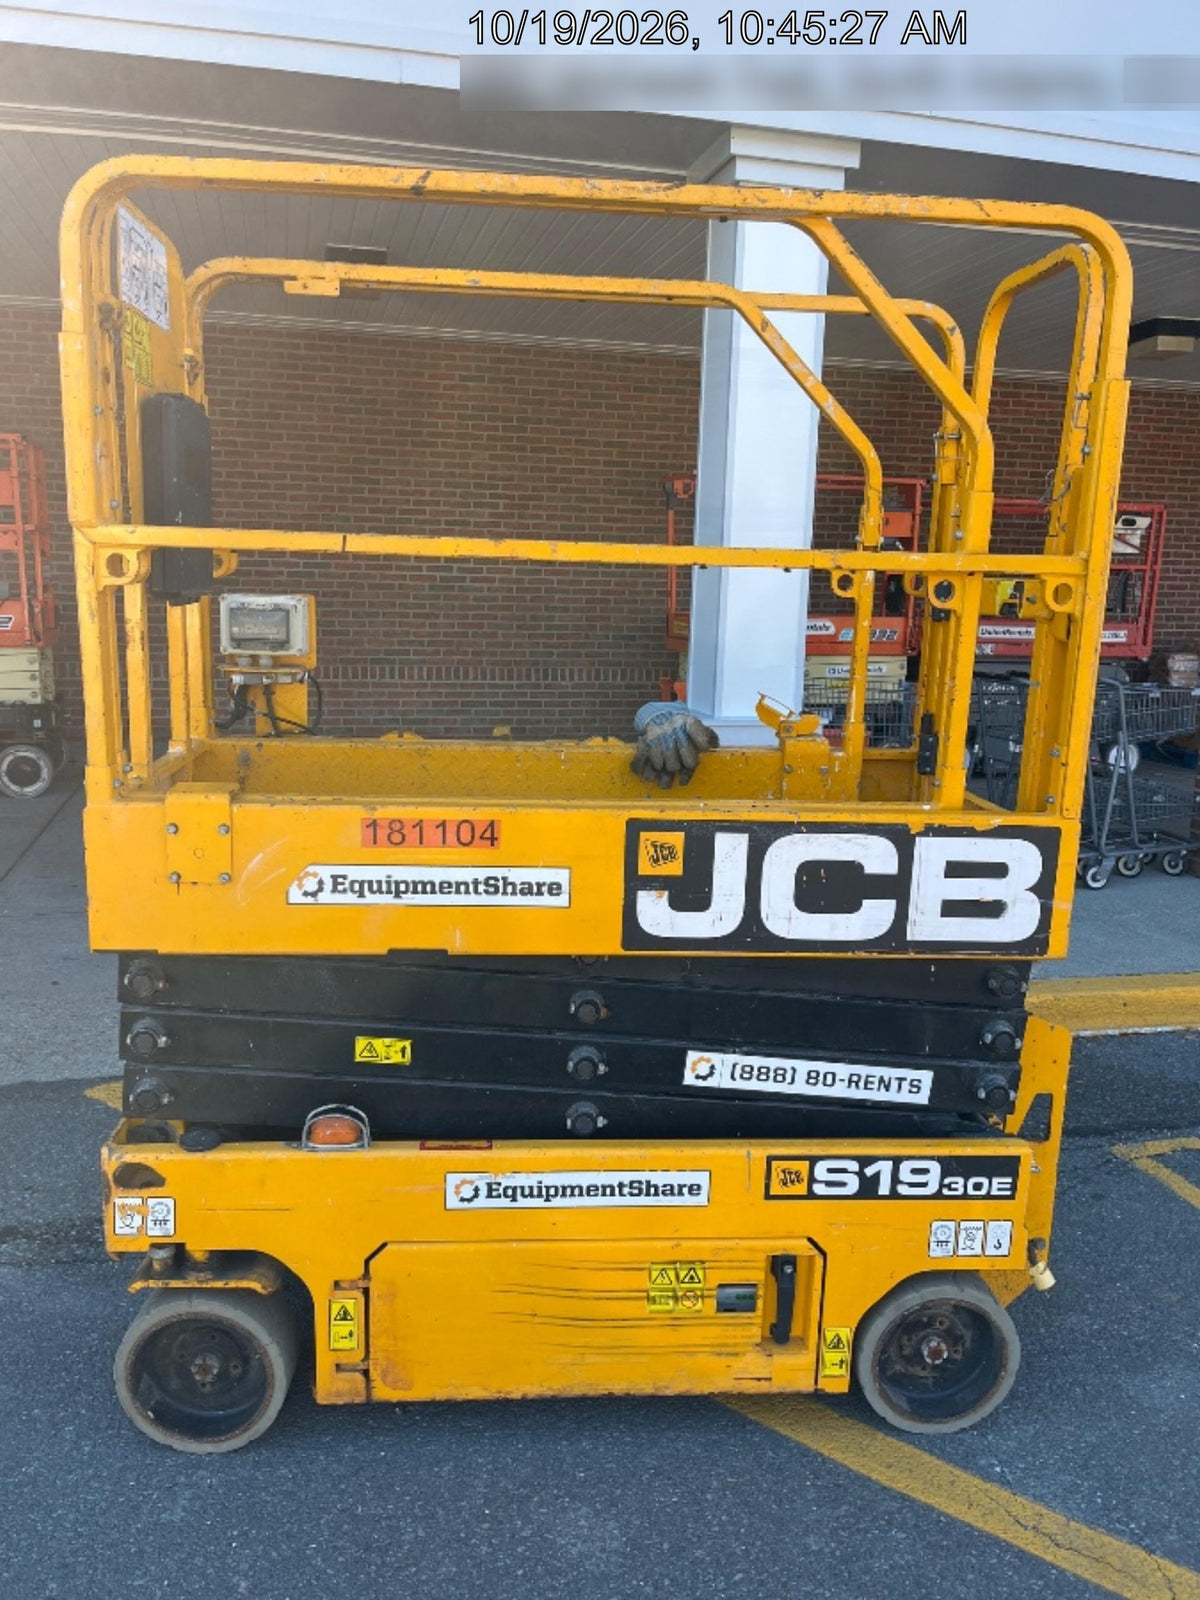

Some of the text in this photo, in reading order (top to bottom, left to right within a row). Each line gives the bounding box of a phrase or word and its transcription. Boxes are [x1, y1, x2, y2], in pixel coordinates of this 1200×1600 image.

[365, 819, 498, 847] 181104
[649, 840, 680, 867] JCB
[329, 873, 563, 899] EquipmentShare
[636, 832, 1043, 942] JCB
[730, 1062, 923, 1095] (888) 80-RENTS
[484, 1179, 703, 1203] EquipmentShare
